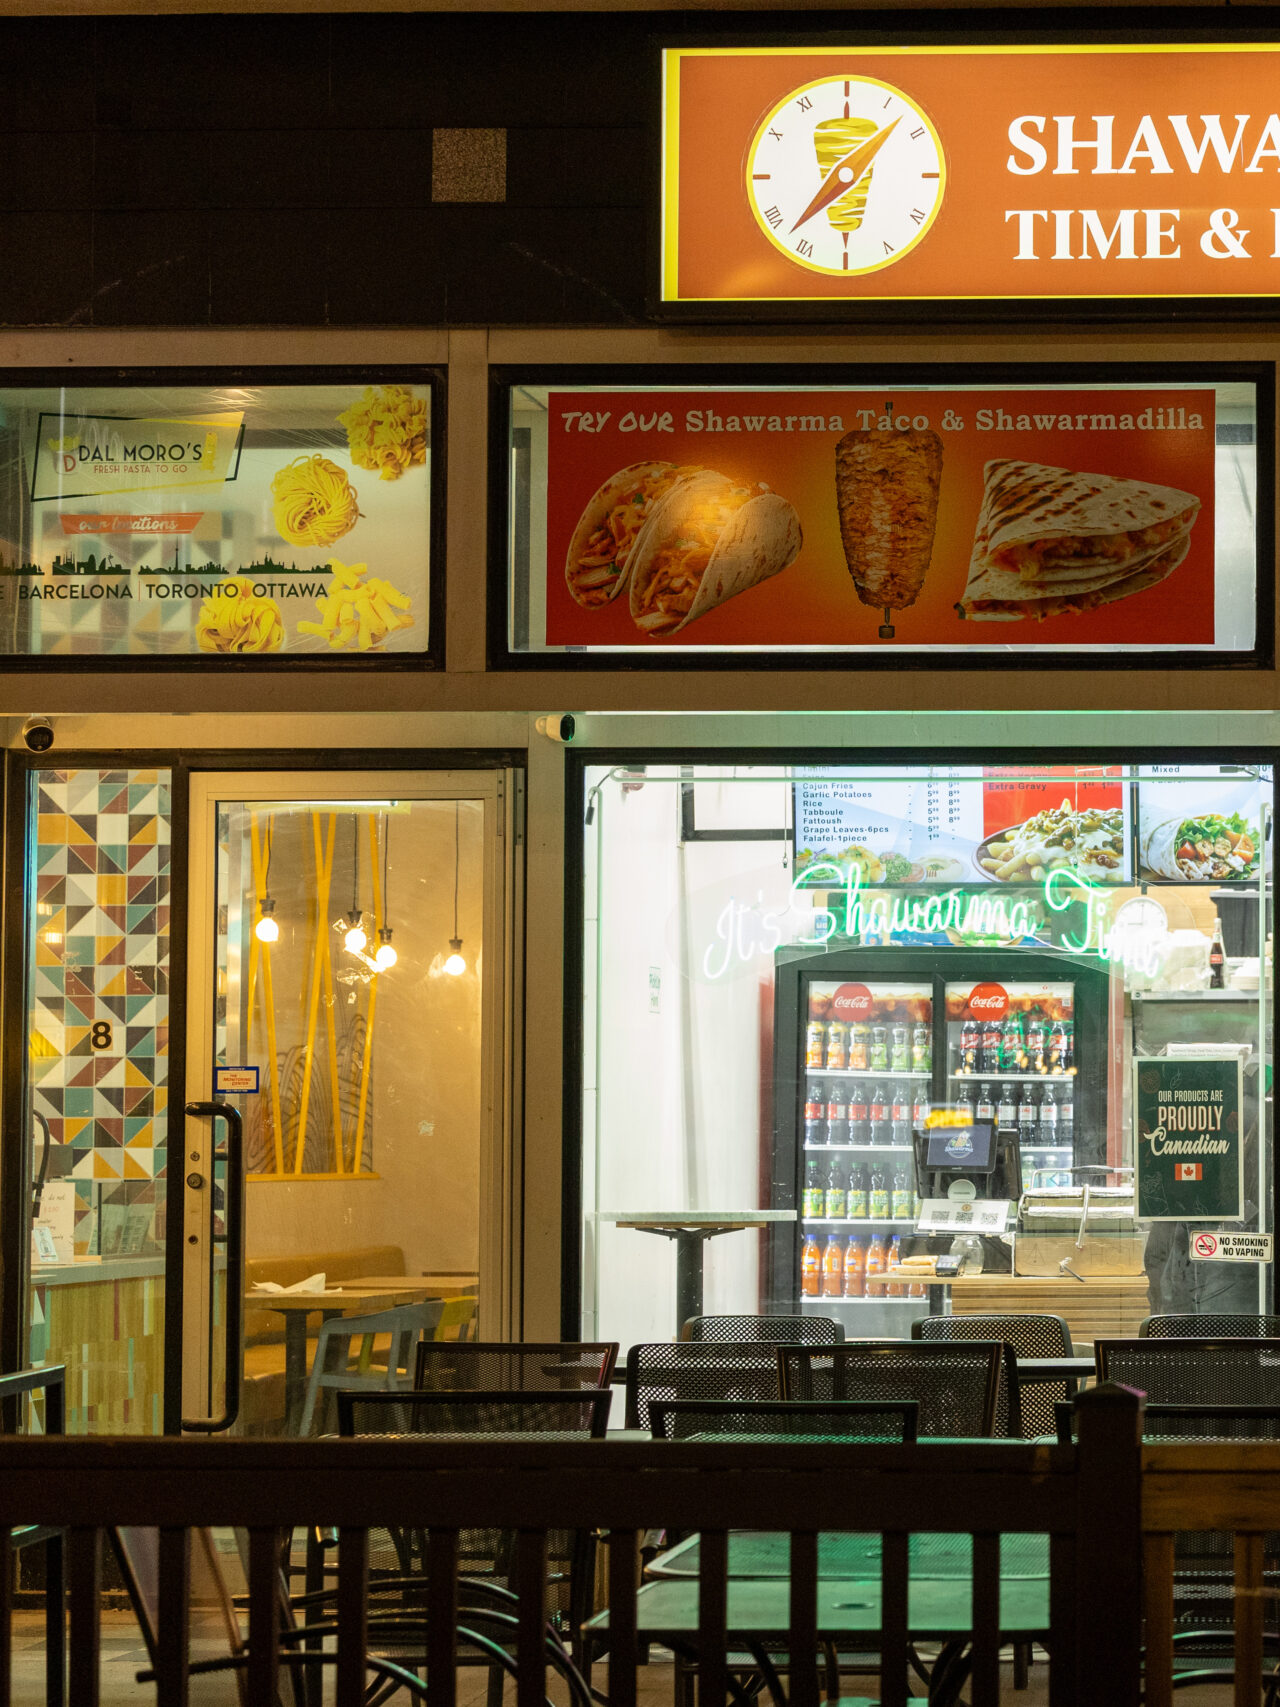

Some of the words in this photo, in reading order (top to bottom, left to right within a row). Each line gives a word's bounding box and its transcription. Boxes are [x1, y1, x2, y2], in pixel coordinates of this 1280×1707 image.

[796, 96, 813, 112] XI
[768, 127, 784, 141] X
[910, 126, 925, 140] II
[764, 205, 784, 230] VIII
[909, 208, 926, 225] IV
[1004, 208, 1181, 260] TIME
[1200, 208, 1252, 259] &
[796, 239, 813, 258] VII
[882, 240, 895, 255] V
[561, 411, 611, 433] TRY
[618, 412, 674, 433] OUR
[685, 409, 844, 433] Shawarma
[856, 409, 929, 432] Taco
[941, 409, 965, 432] &
[976, 407, 1204, 431] Shawarmadilla
[78, 445, 114, 462] DAL
[123, 443, 202, 461] MORO'S
[94, 464, 120, 474] FRESH
[124, 464, 150, 473] PASTA
[156, 464, 169, 473] TO
[172, 464, 188, 473] GO
[19, 584, 133, 600] BARCELONA
[146, 583, 239, 599] TORONTO
[252, 582, 328, 599] OTTAWA
[803, 782, 828, 790] Cajun
[988, 782, 1015, 790] Extra
[1018, 783, 1047, 792] Gravy
[803, 817, 842, 825] Fattoush
[803, 826, 830, 834] Grape
[789, 863, 1037, 944] Shawarma
[834, 996, 870, 1009] Coca-Cola
[970, 995, 1006, 1008] Coca-Cola
[92, 1021, 112, 1049] 8
[1158, 1090, 1172, 1103] OUR
[1175, 1090, 1208, 1102] PRODUCTS
[1210, 1090, 1223, 1101] ARE
[1157, 1105, 1223, 1131] PROUDLY
[1143, 1126, 1230, 1156] Canadian
[1219, 1236, 1231, 1246] NO
[1233, 1237, 1268, 1247] SMOKING
[1222, 1247, 1234, 1256] NO
[1236, 1247, 1264, 1257] VAPING
